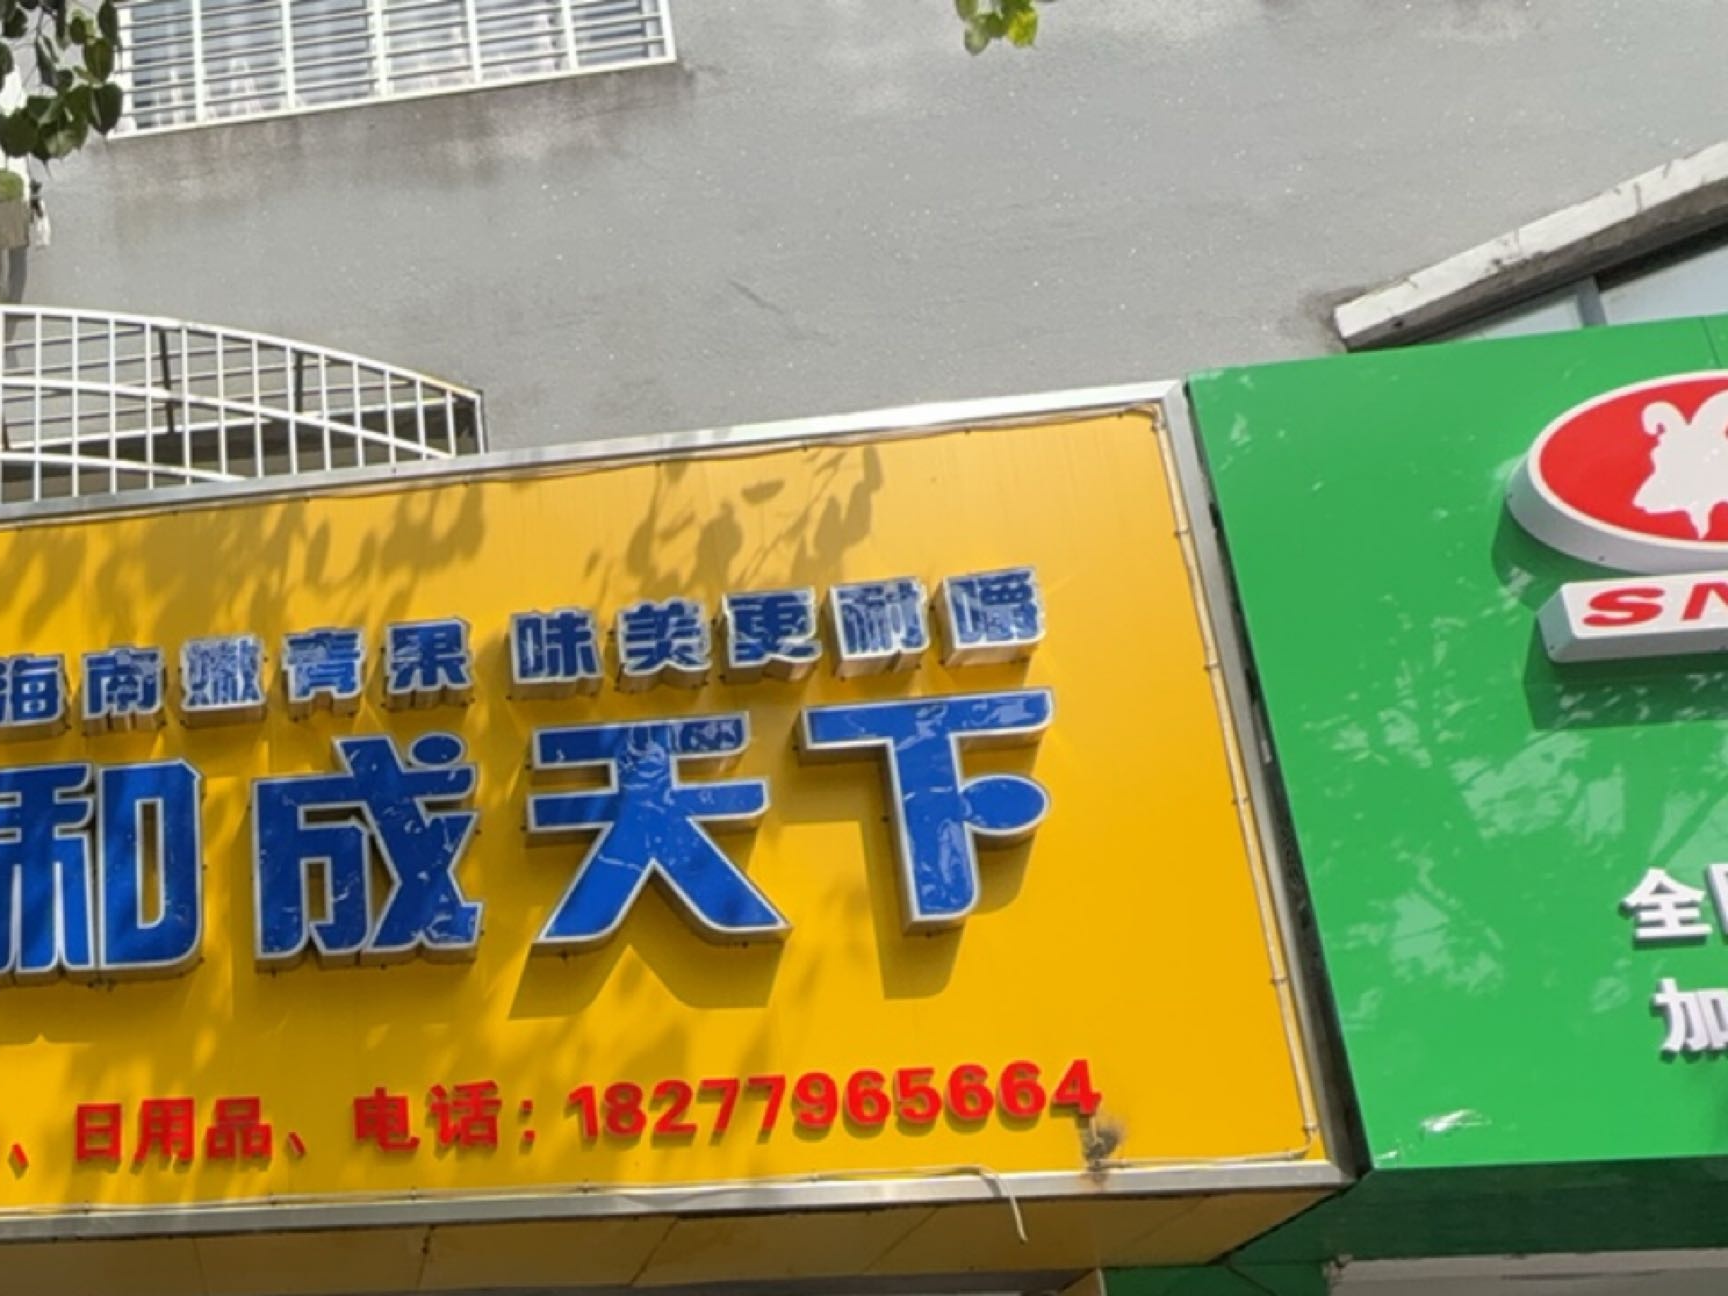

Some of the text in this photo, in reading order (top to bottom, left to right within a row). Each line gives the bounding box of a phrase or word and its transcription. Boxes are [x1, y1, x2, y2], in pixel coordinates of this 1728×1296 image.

[509, 566, 1047, 698] 味美更耐嚼
[1622, 863, 1728, 944] 全
